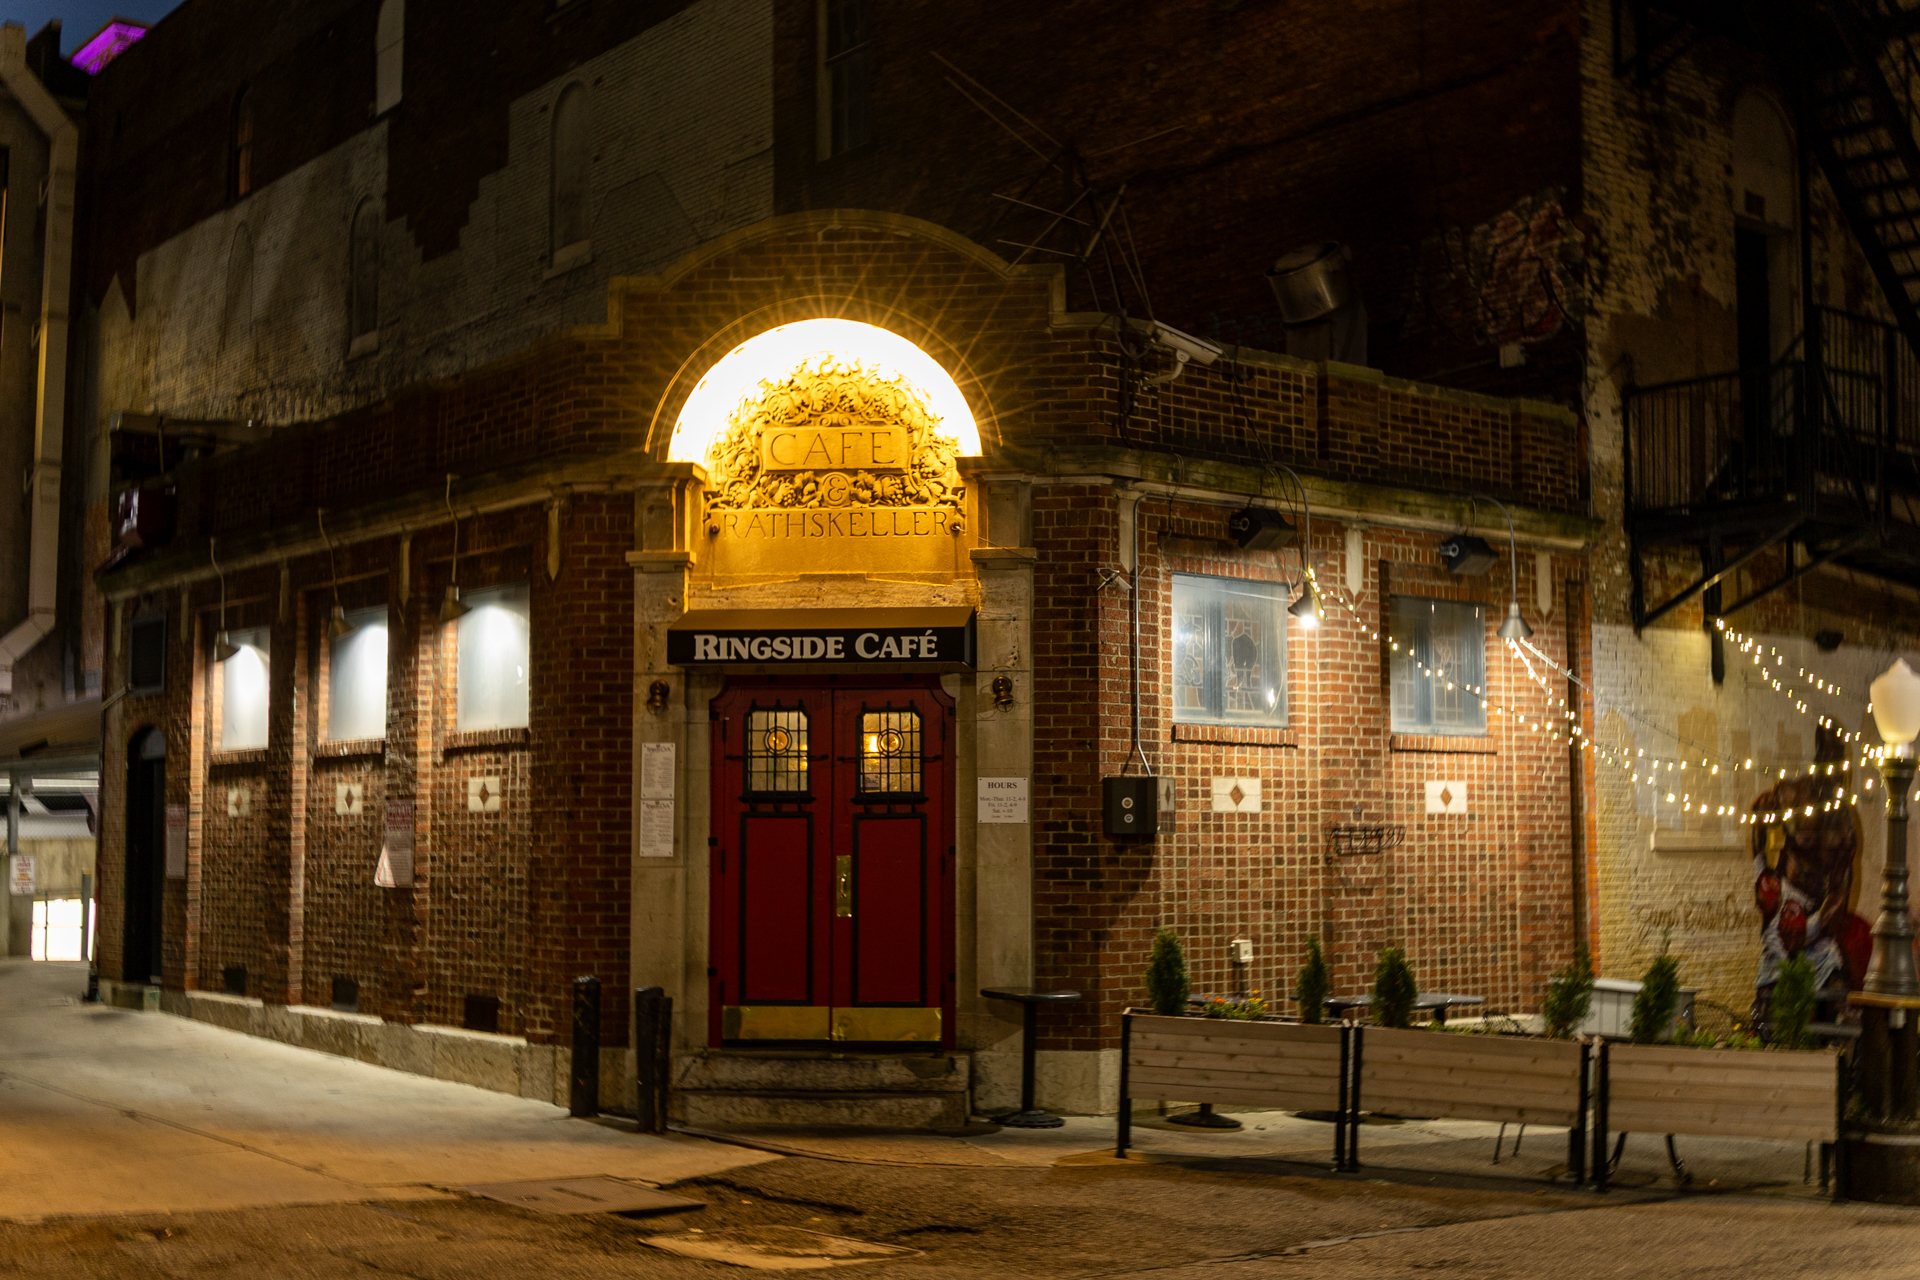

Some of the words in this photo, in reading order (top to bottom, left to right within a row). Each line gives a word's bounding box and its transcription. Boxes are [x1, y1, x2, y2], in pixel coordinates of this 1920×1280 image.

[770, 431, 896, 466] CAFE
[826, 476, 847, 502] &
[723, 511, 950, 539] RATHSKELLER
[693, 634, 845, 661] RINGSIDE
[855, 629, 938, 660] CAFÉ
